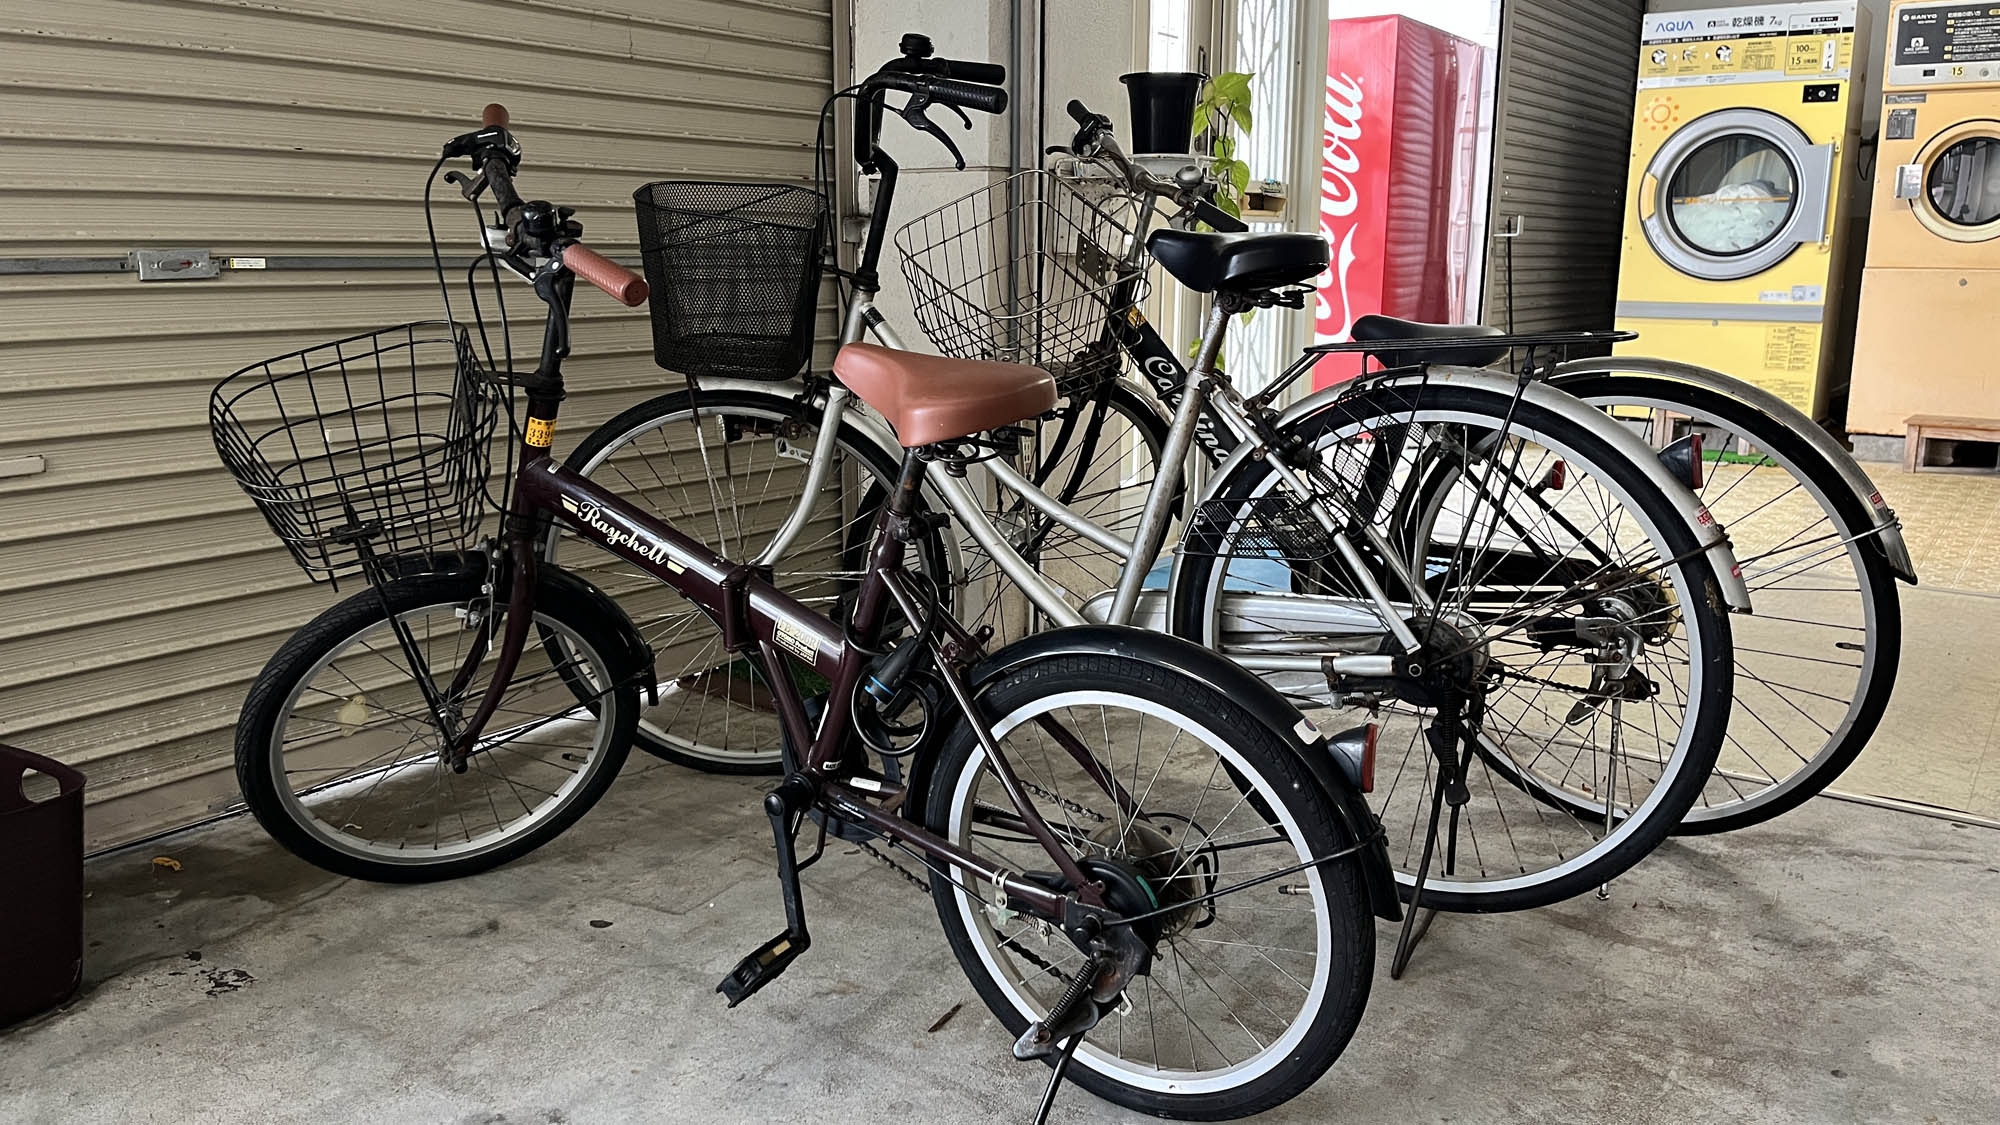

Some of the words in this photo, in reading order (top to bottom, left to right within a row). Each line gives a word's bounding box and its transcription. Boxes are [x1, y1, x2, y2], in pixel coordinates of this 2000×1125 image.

[1655, 20, 1694, 32] AQUA
[1732, 16, 1765, 27] 乾燥機
[1796, 44, 1810, 53] 100
[1791, 57, 1801, 65] 15
[1952, 67, 1963, 76] 15
[530, 428, 552, 439] 339
[577, 501, 667, 565] Raychell
